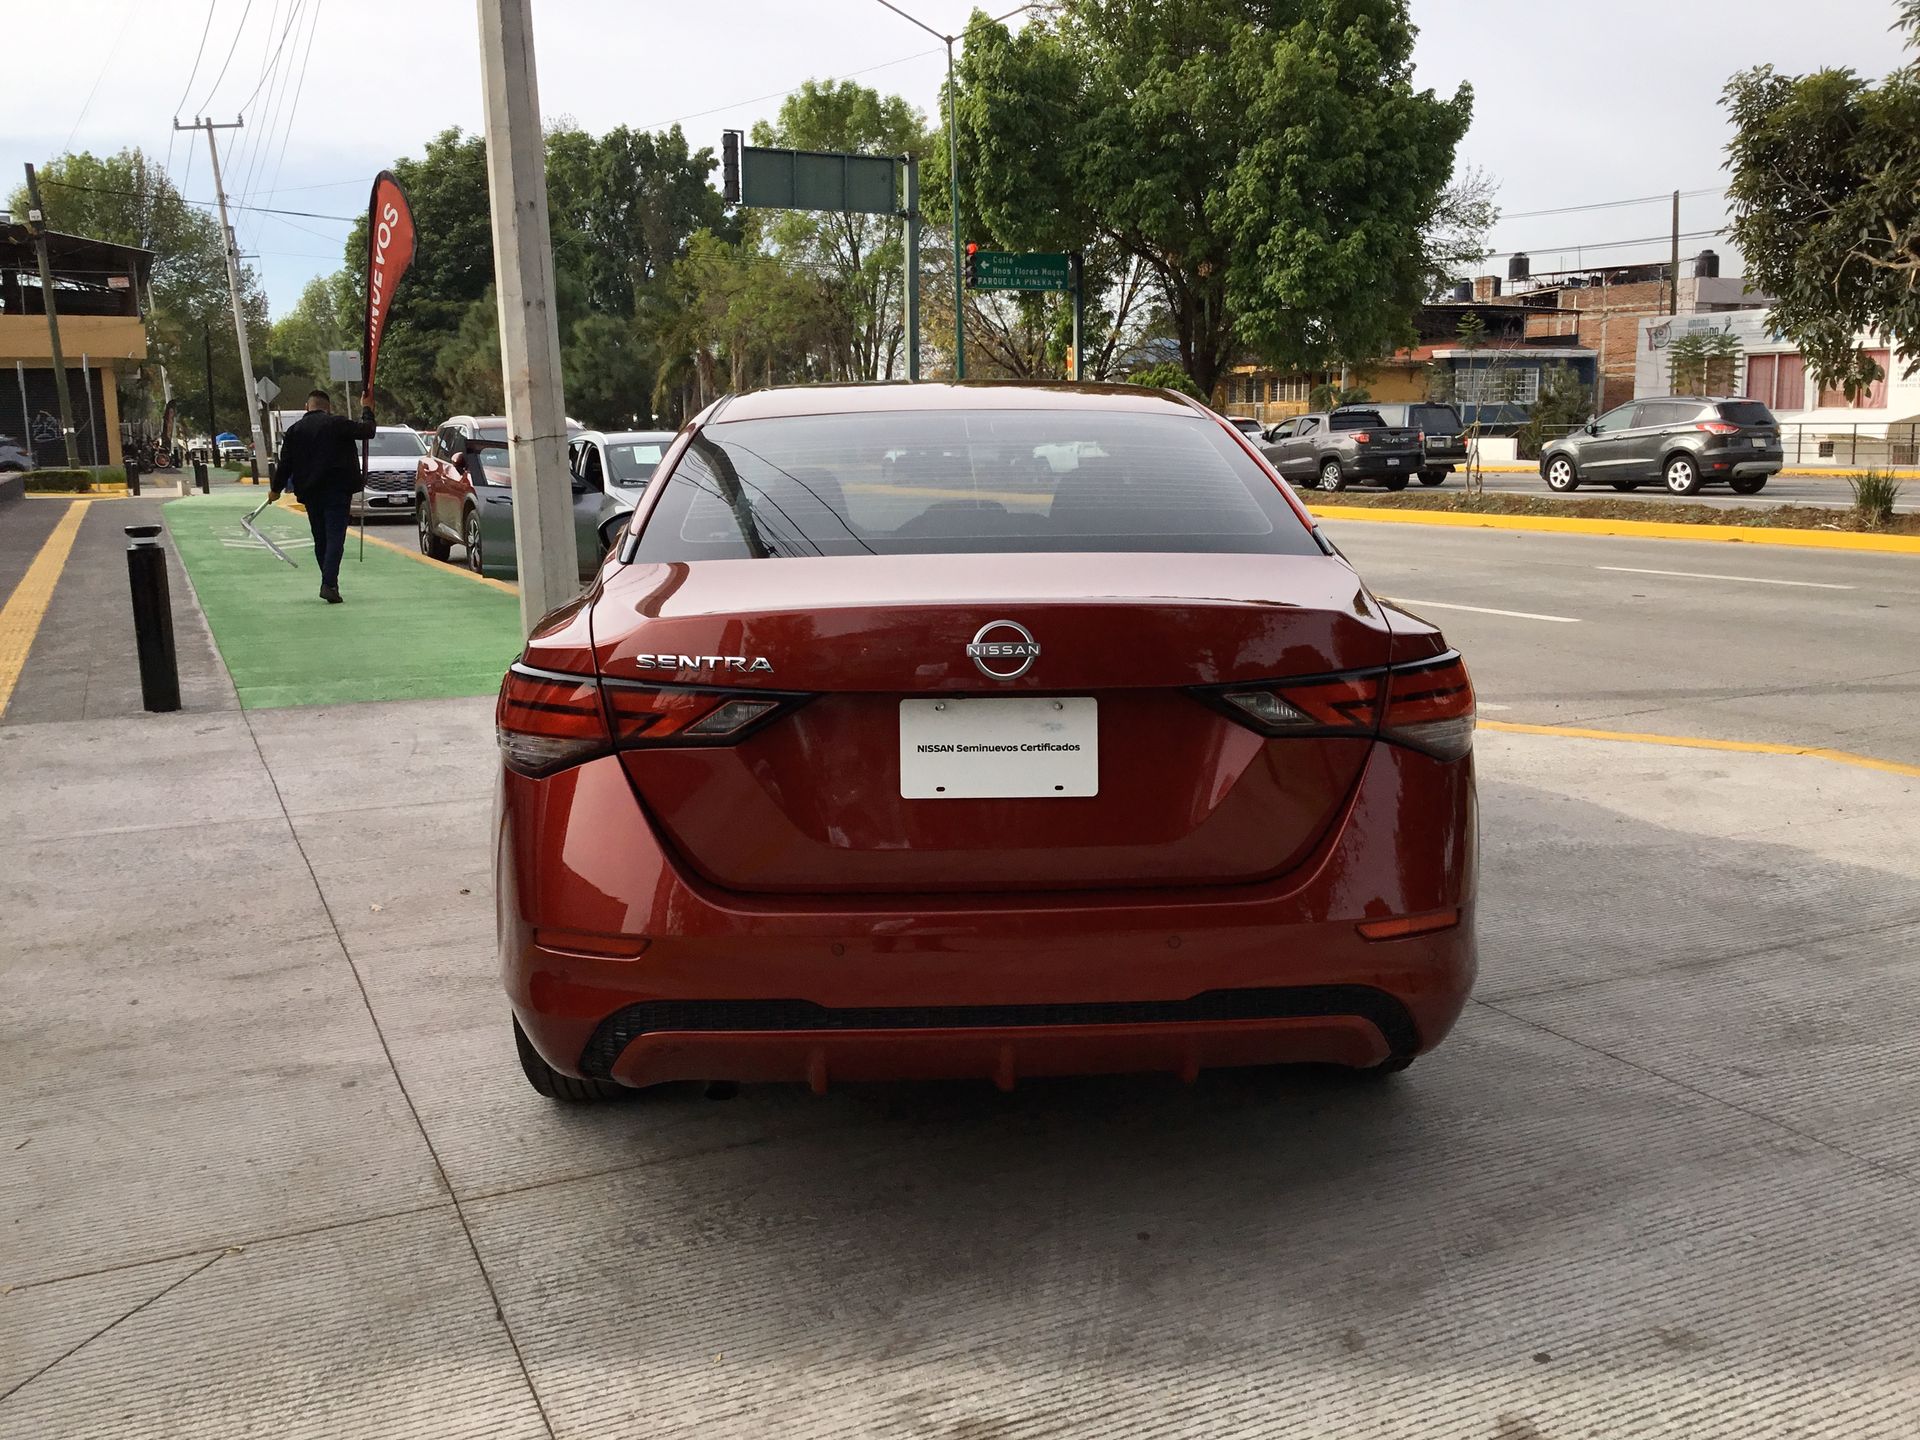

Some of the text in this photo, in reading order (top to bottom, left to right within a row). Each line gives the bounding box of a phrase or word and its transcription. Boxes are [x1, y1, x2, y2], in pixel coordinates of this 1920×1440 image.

[993, 267, 1011, 275] Hnos
[1015, 267, 1039, 275] Flores
[977, 277, 1007, 286] PARQUE
[1010, 277, 1021, 286] LA
[968, 645, 1039, 656] NISSAN
[635, 654, 774, 673] SENTRA
[917, 742, 1081, 753] NISSAN Seminuevos Certificados
